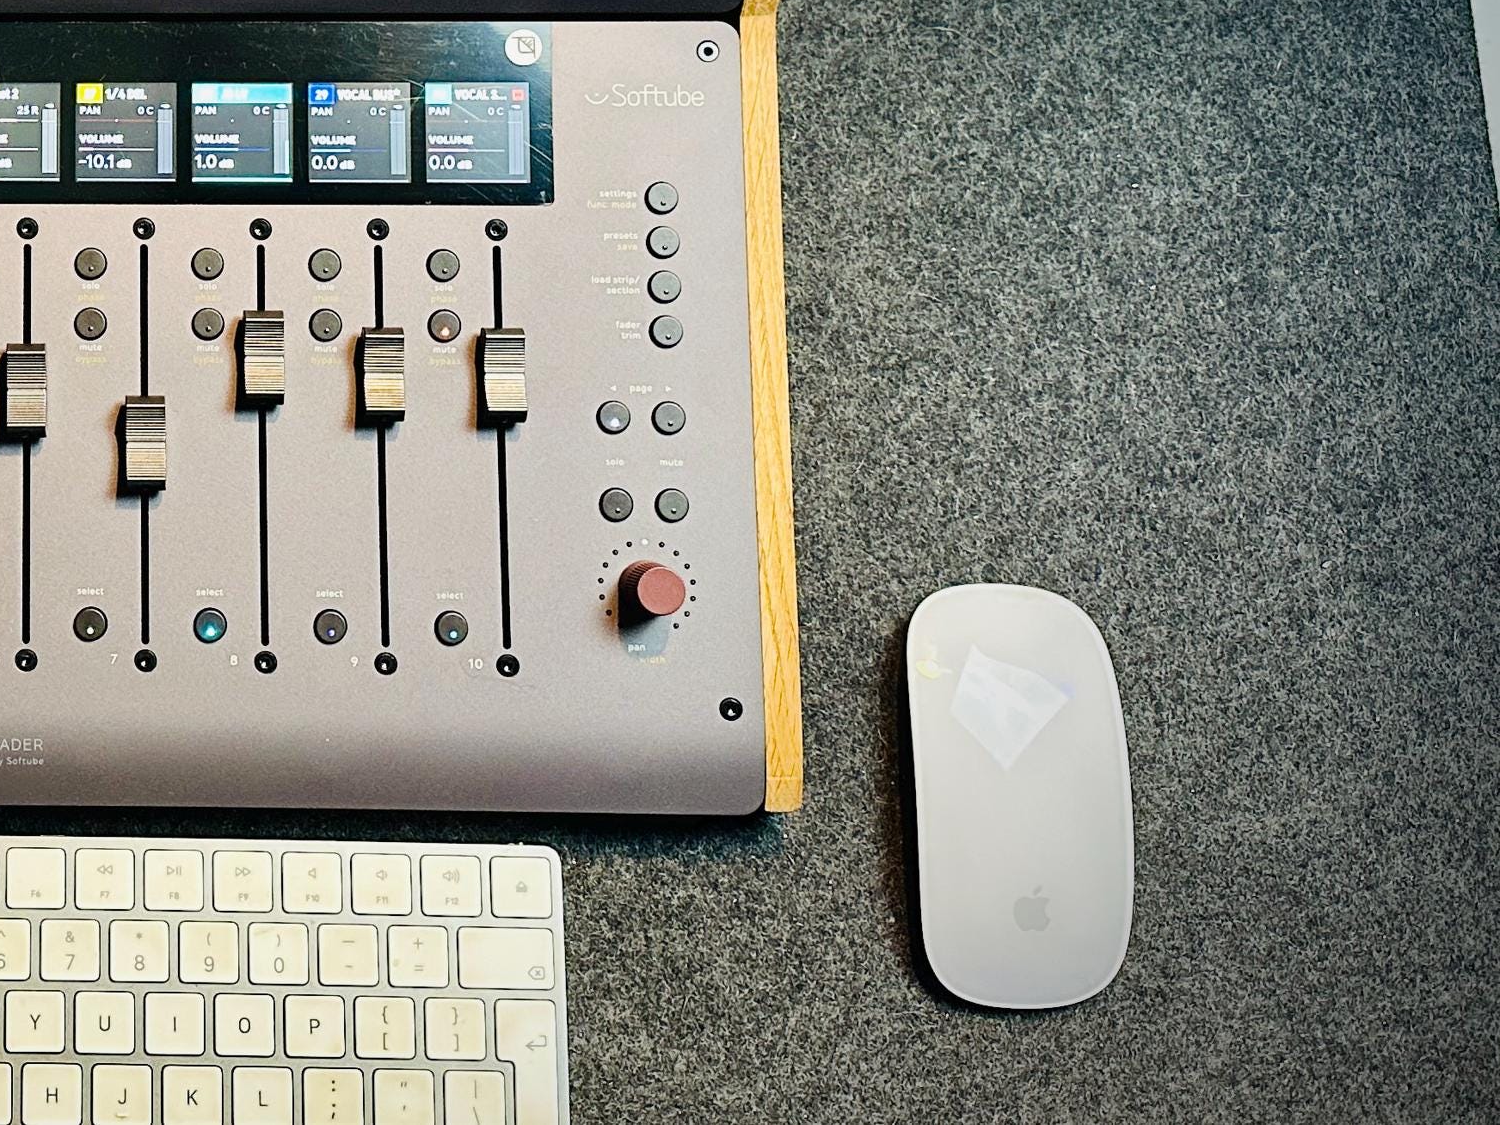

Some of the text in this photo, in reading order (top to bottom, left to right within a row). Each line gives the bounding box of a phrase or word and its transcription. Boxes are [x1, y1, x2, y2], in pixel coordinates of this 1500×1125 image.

[314, 89, 372, 101] 29 VOCAL
[611, 84, 705, 107] Softube
[79, 106, 101, 116] PAN
[310, 135, 356, 145] VOLUME
[78, 154, 115, 169] -10.1
[194, 154, 218, 169] 1.0
[311, 155, 338, 170] 0.0
[599, 189, 637, 200] settings
[196, 588, 224, 597] select
[628, 643, 646, 652] pan
[110, 653, 118, 665] 7
[468, 658, 483, 670] 10
[6, 756, 44, 765] Softube
[376, 896, 389, 904] F11
[65, 954, 76, 970] 7
[204, 956, 215, 972] 9
[99, 1015, 111, 1032] U
[309, 1018, 321, 1035] P
[186, 1089, 199, 1106] K
